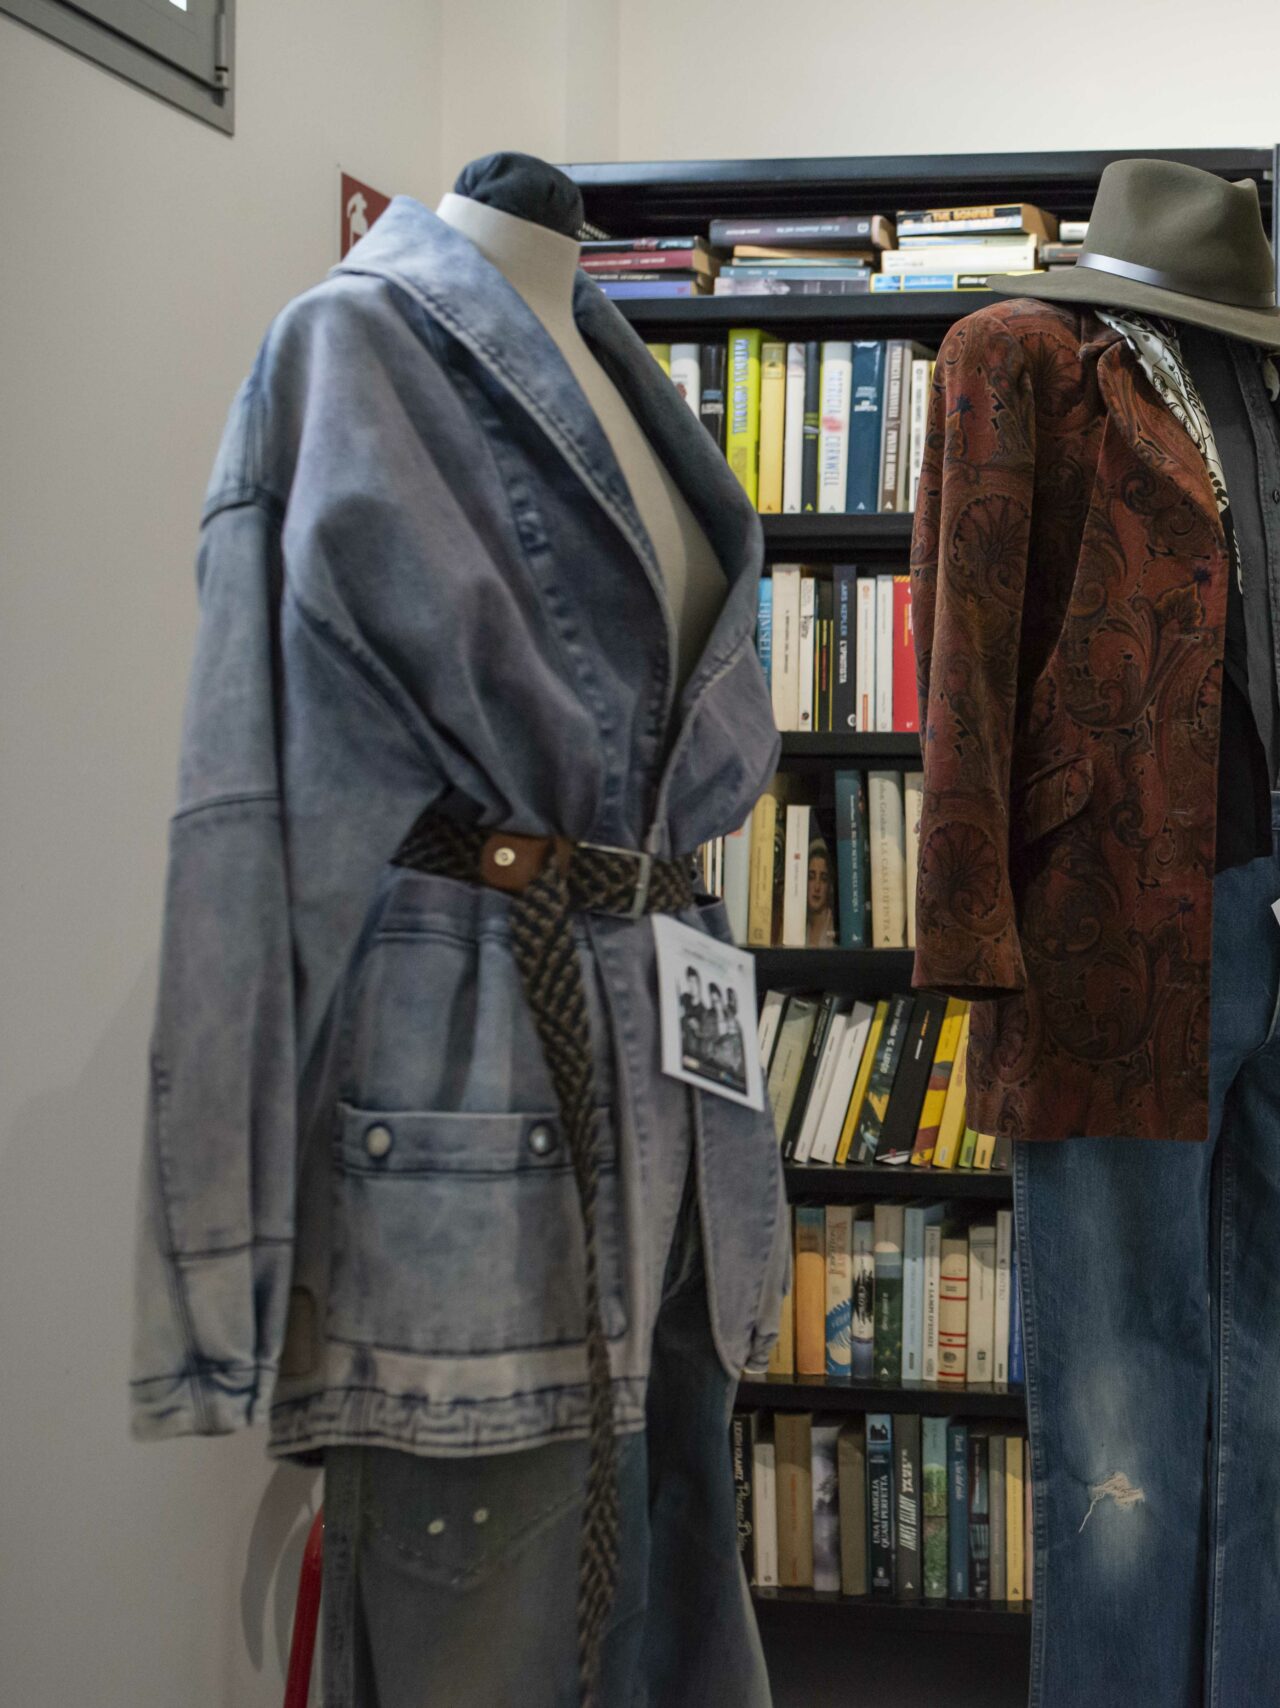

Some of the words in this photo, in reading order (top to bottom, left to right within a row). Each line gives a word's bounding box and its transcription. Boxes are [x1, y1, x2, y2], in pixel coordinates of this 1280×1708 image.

[734, 339, 749, 382] PATRICIA
[733, 386, 749, 435] CORNWELL
[828, 370, 843, 414] PATRICIA
[824, 436, 841, 487] CORNWELL
[840, 580, 848, 601] LARS
[879, 802, 887, 840] Grisham
[880, 858, 889, 884] CASA
[872, 1479, 880, 1523] FAMIGLIA
[880, 1475, 888, 1519] PERFETTA
[881, 1520, 890, 1548] QUASI
[899, 1523, 916, 1551] JAMES
